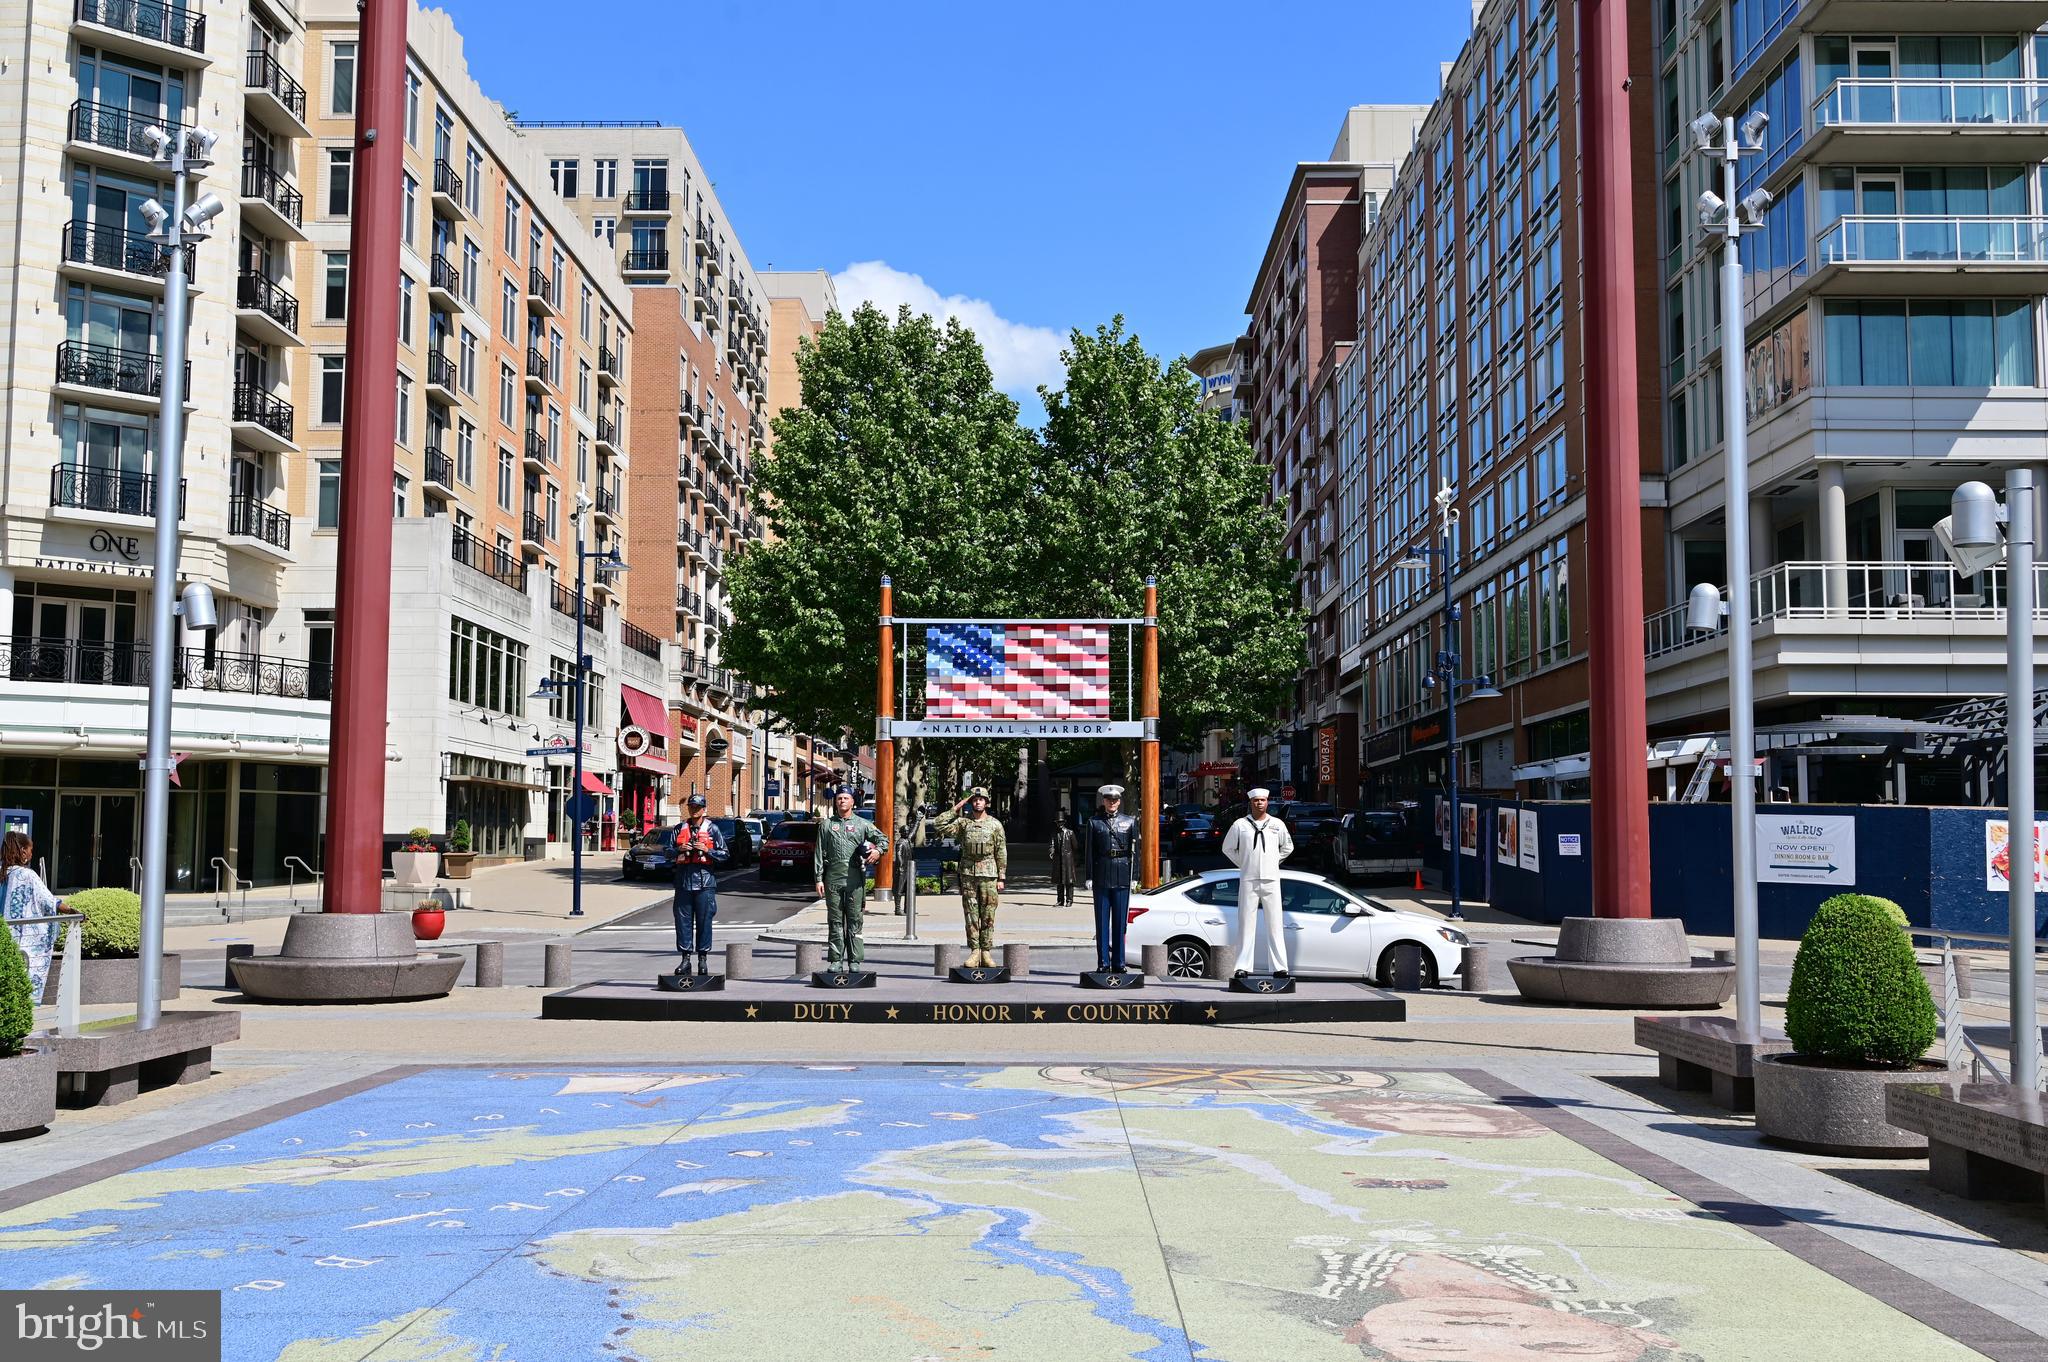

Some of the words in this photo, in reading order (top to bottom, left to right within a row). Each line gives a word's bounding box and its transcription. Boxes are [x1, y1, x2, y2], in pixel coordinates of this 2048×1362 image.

[1208, 374, 1232, 389] WYN
[89, 529, 140, 561] ONE
[35, 558, 117, 575] NATIONAL
[128, 568, 188, 581] HAR
[932, 724, 1015, 735] NATIONAL
[1039, 724, 1104, 735] HARBOR
[1321, 732, 1330, 781] BOMBAY
[1780, 825, 1823, 837] WALRUS
[1560, 836, 1579, 844] NOTICE
[794, 1003, 855, 1021] DUTY
[933, 1003, 1012, 1021] HONOR
[1067, 1003, 1174, 1022] COUNTRY
